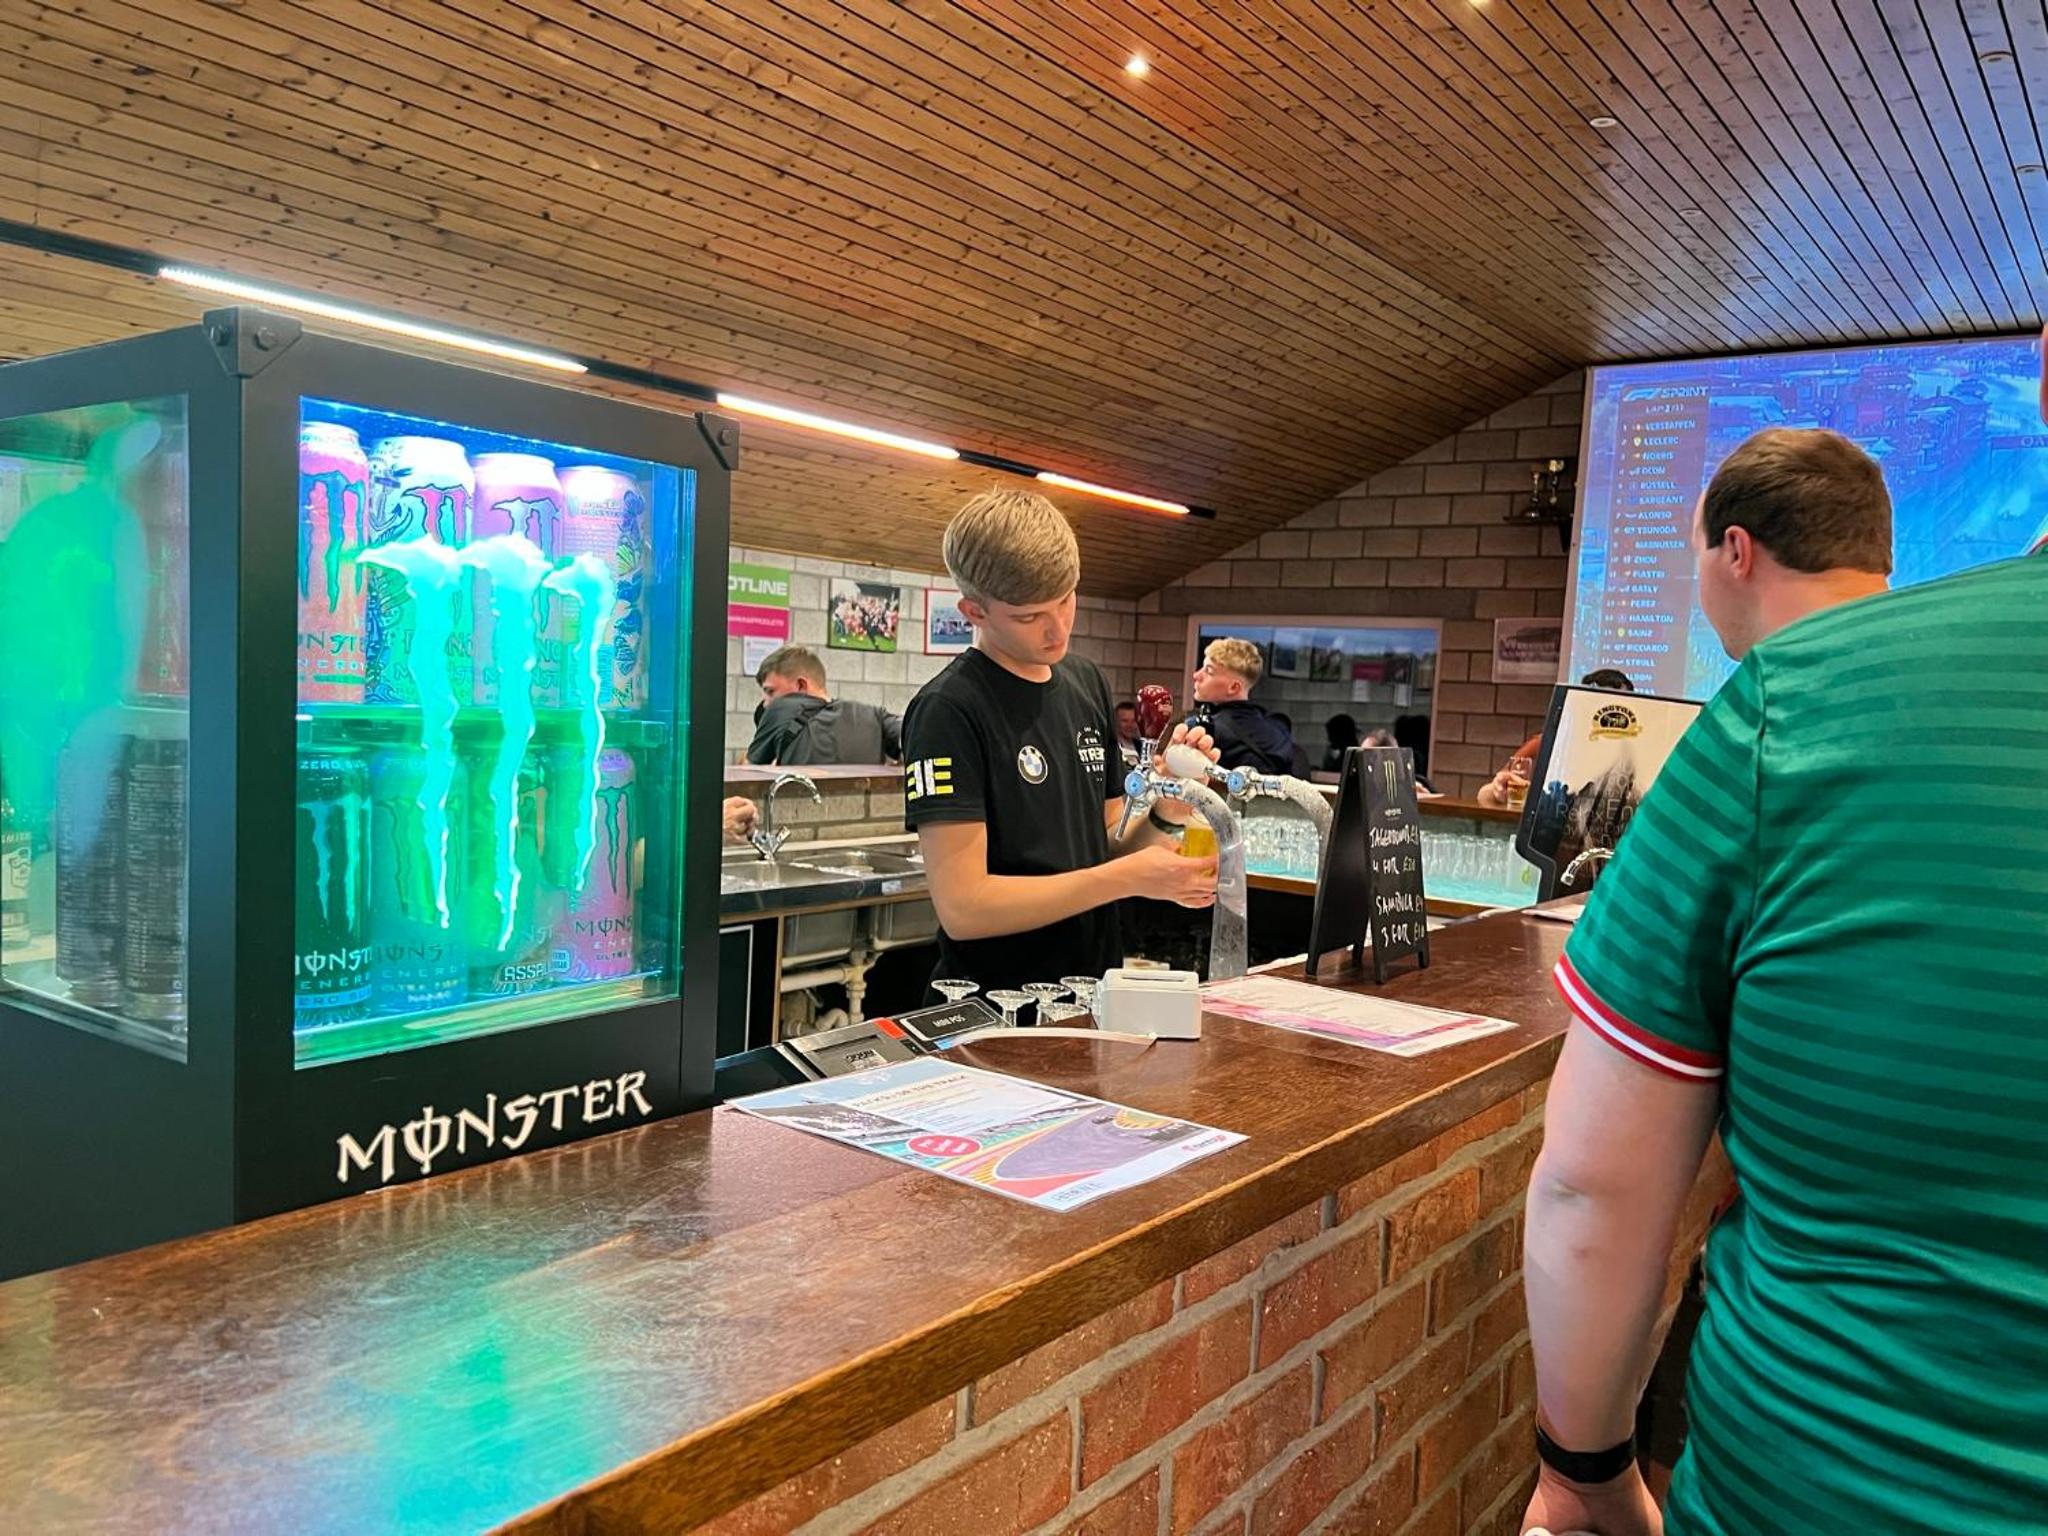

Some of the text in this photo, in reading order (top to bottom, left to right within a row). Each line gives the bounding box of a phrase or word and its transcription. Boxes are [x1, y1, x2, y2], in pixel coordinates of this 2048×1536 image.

[1661, 386, 1709, 398] SPRINT
[1645, 420, 1696, 431] VERSTAPPEN
[1643, 436, 1679, 446] LECLERC
[1638, 511, 1672, 520] ALONSO
[1637, 526, 1678, 535] TSUNODA
[1629, 614, 1674, 624] HAMILTON
[1391, 923, 1412, 946] FOR
[337, 1070, 654, 1185] MONSTER
